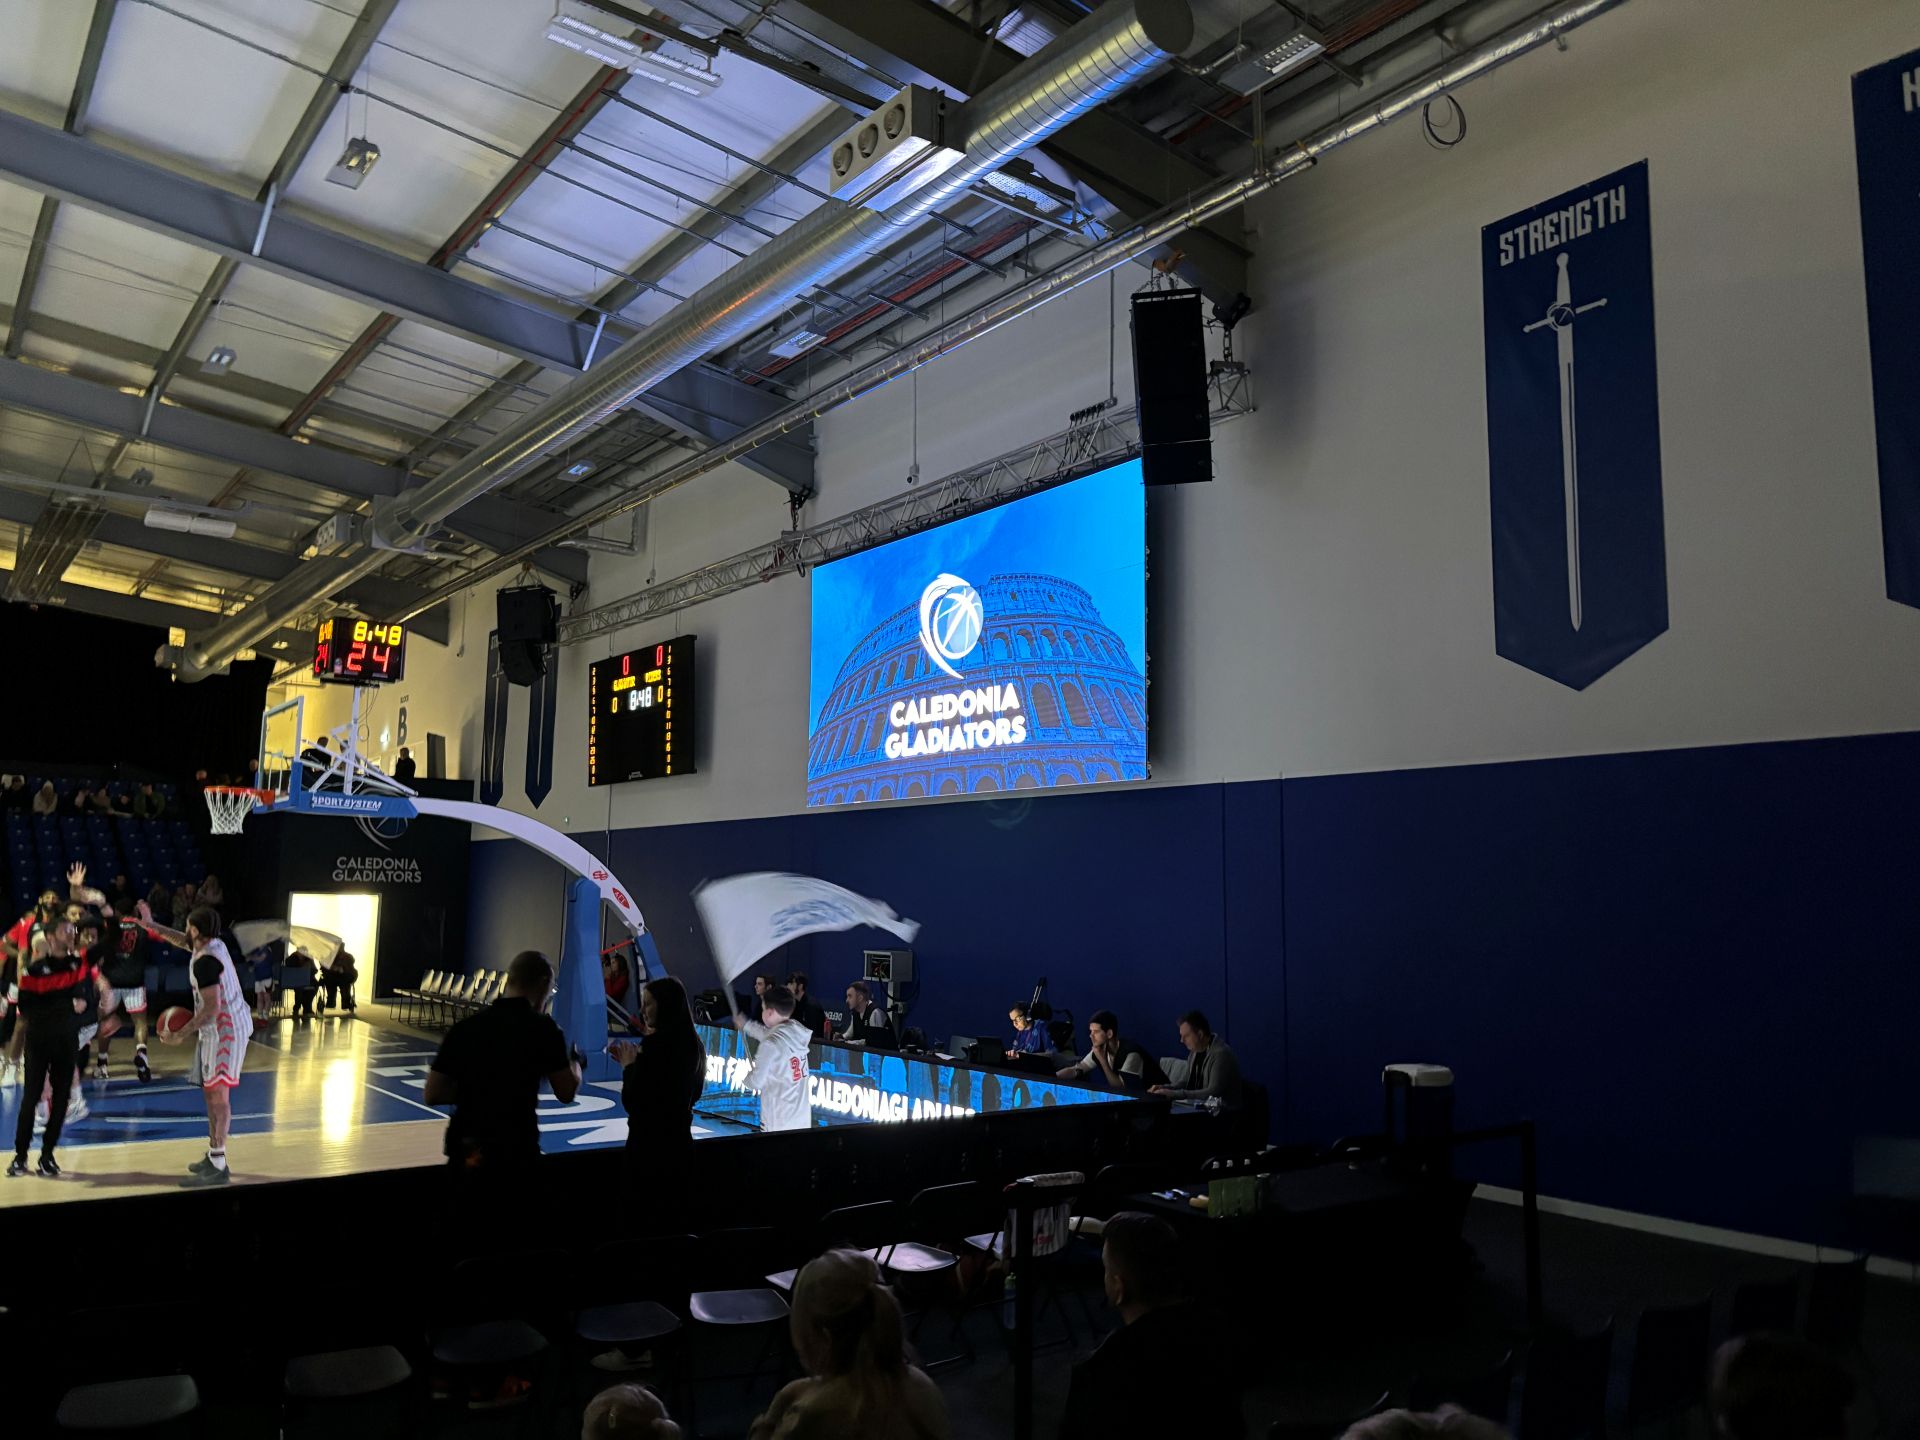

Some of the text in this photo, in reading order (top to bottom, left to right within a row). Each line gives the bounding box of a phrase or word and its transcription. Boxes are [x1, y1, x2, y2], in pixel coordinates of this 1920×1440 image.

[1499, 184, 1627, 267] STRENGTH
[346, 641, 391, 673] 24
[622, 655, 630, 676] 0
[656, 645, 664, 667] 0
[657, 685, 664, 703] 0
[889, 682, 1021, 728] CALEDONIA
[612, 697, 618, 714] 0
[397, 706, 408, 748] B
[884, 715, 1027, 759] GLADIATORS
[336, 856, 420, 871] CALEDONIA
[332, 869, 422, 884] GLADIATORS
